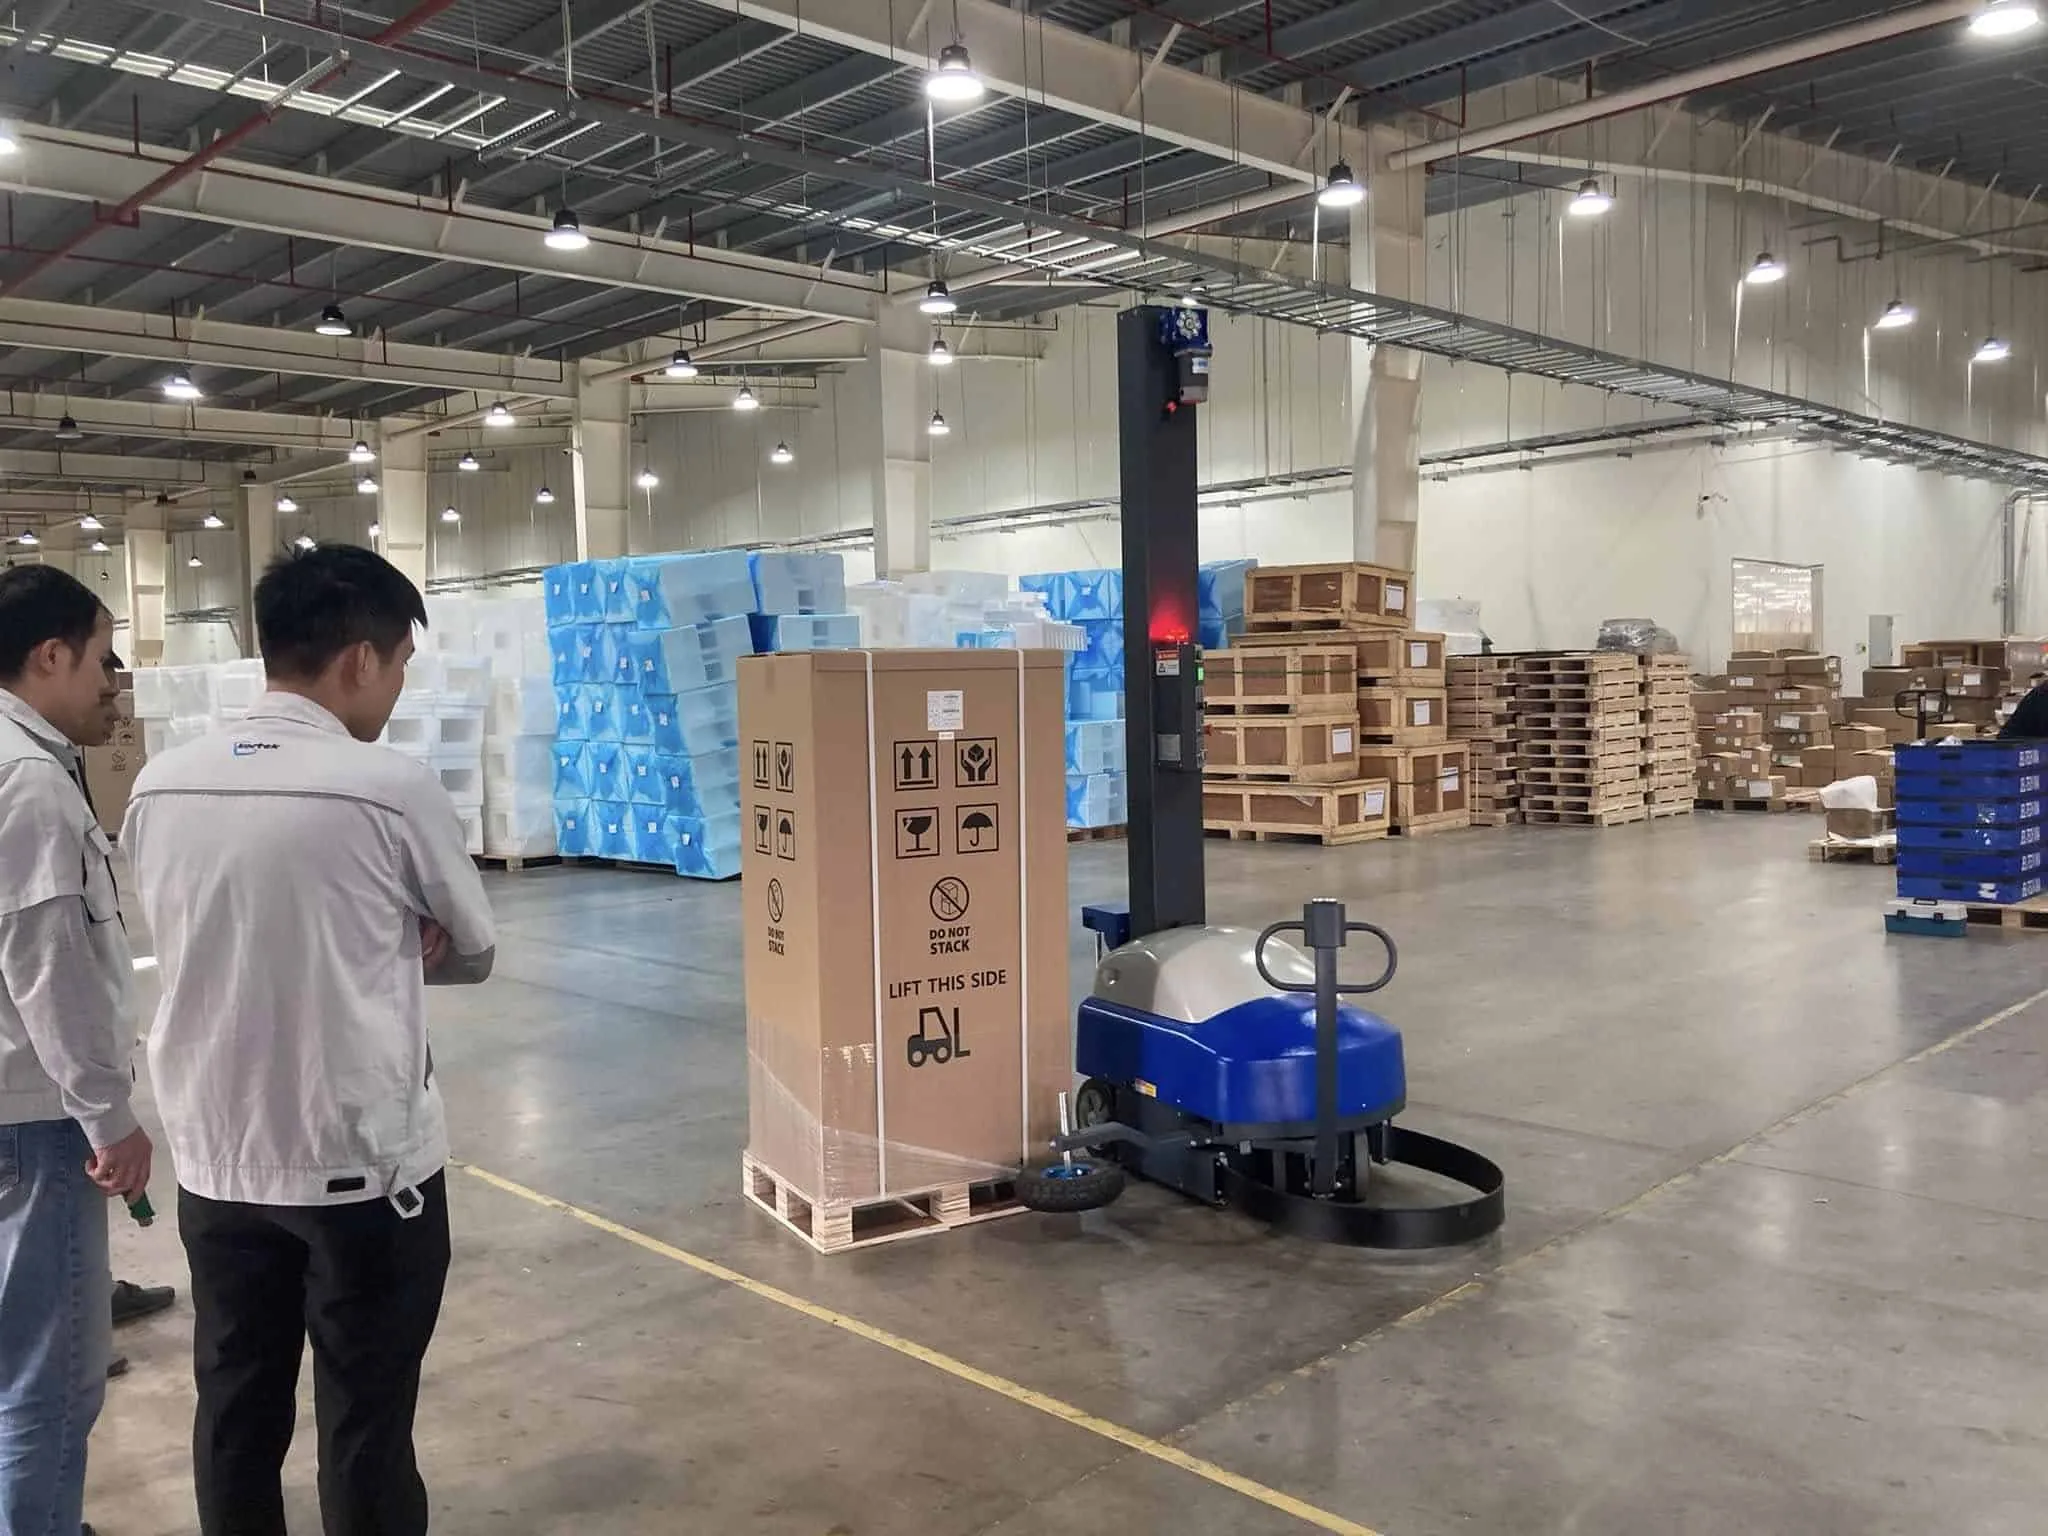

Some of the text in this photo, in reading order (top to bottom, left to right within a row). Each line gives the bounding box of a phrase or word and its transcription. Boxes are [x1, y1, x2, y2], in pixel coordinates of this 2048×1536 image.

[929, 926, 971, 940] DO NOT
[930, 939, 970, 955] STACK
[889, 969, 1007, 999] LIFT THIS SIDE
